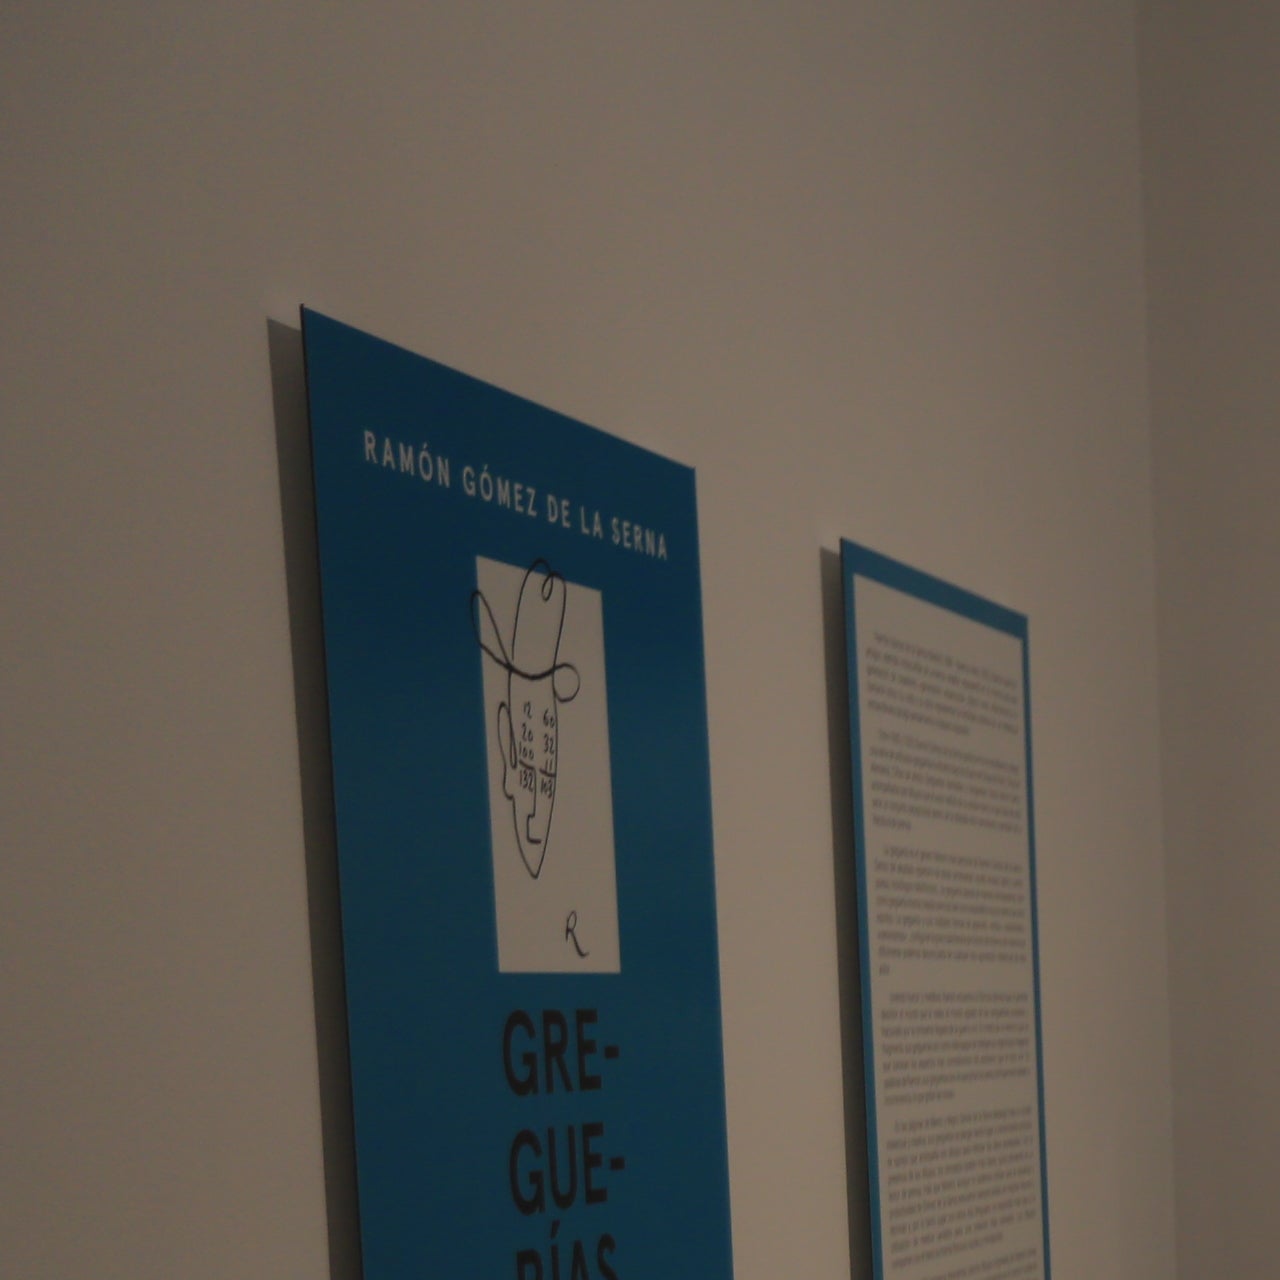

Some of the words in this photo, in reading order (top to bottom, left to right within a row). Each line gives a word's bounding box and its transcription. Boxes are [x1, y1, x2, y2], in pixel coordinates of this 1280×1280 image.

[364, 430, 450, 488] RAMÓN
[462, 463, 538, 517] GÓMEZ
[547, 494, 572, 528] DE
[581, 505, 604, 539] LA
[612, 517, 669, 561] SERNA
[503, 1009, 620, 1096] GRE-
[510, 1122, 625, 1216] GUE-
